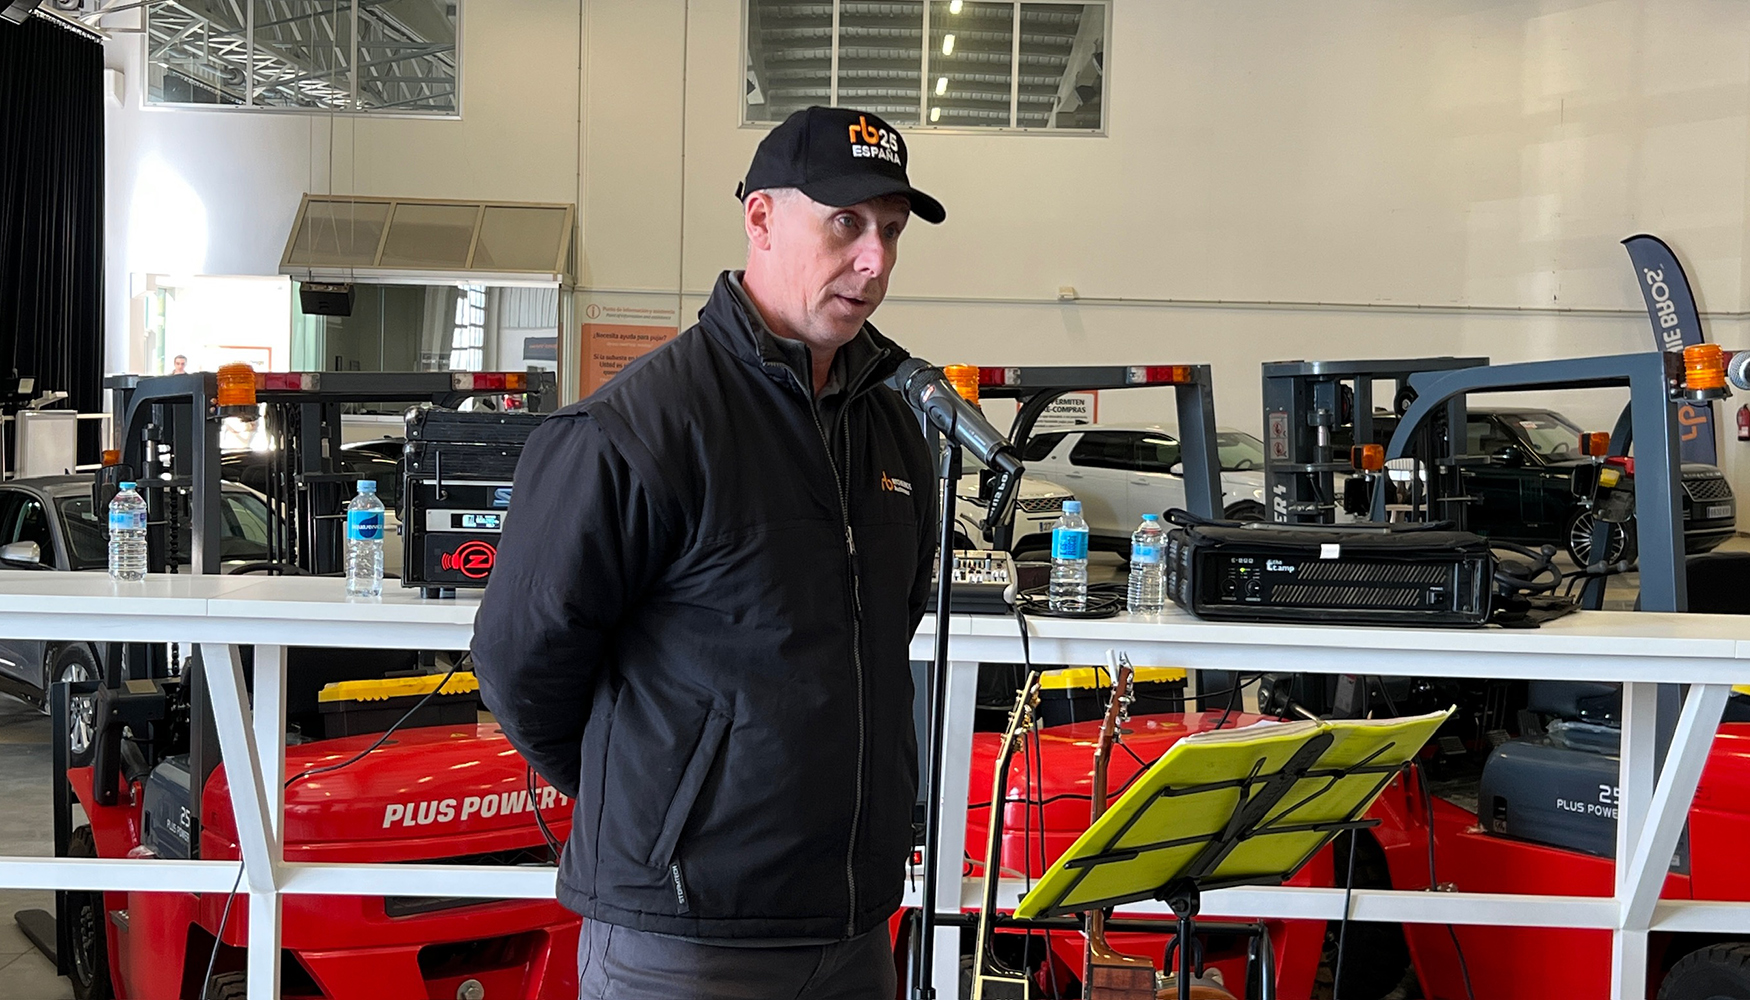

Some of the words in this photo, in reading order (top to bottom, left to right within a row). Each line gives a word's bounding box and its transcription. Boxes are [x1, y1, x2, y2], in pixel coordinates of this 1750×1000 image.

[1051, 398, 1085, 406] ERMITEN
[1044, 406, 1087, 414] E-COMPRAS
[382, 798, 457, 828] PLUS
[460, 785, 557, 821] POWER
[1556, 798, 1585, 813] PLUS
[1587, 802, 1618, 819] POWE
